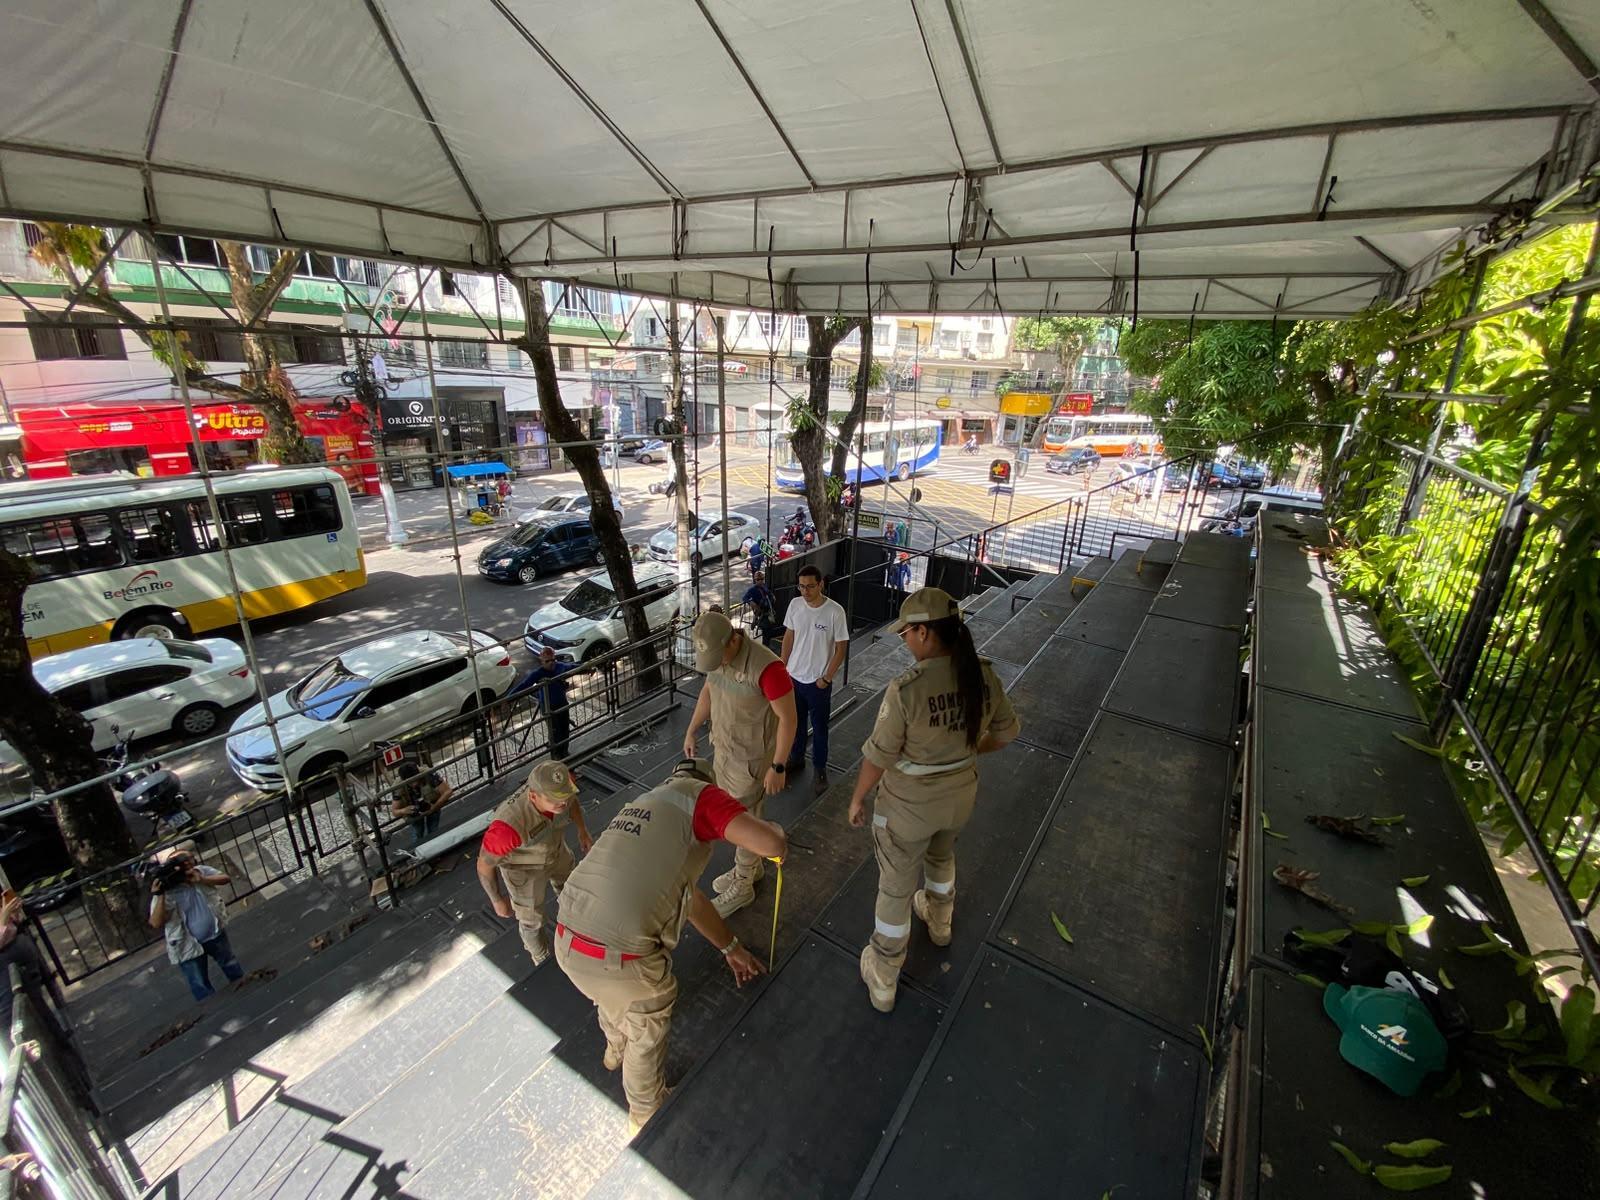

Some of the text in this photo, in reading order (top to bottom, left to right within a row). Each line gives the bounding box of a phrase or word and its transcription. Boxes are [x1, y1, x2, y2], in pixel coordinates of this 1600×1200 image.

[209, 412, 264, 429] Ultra
[388, 415, 446, 425] ORIGINATO
[232, 428, 264, 436] Popular
[150, 581, 173, 591] Rio
